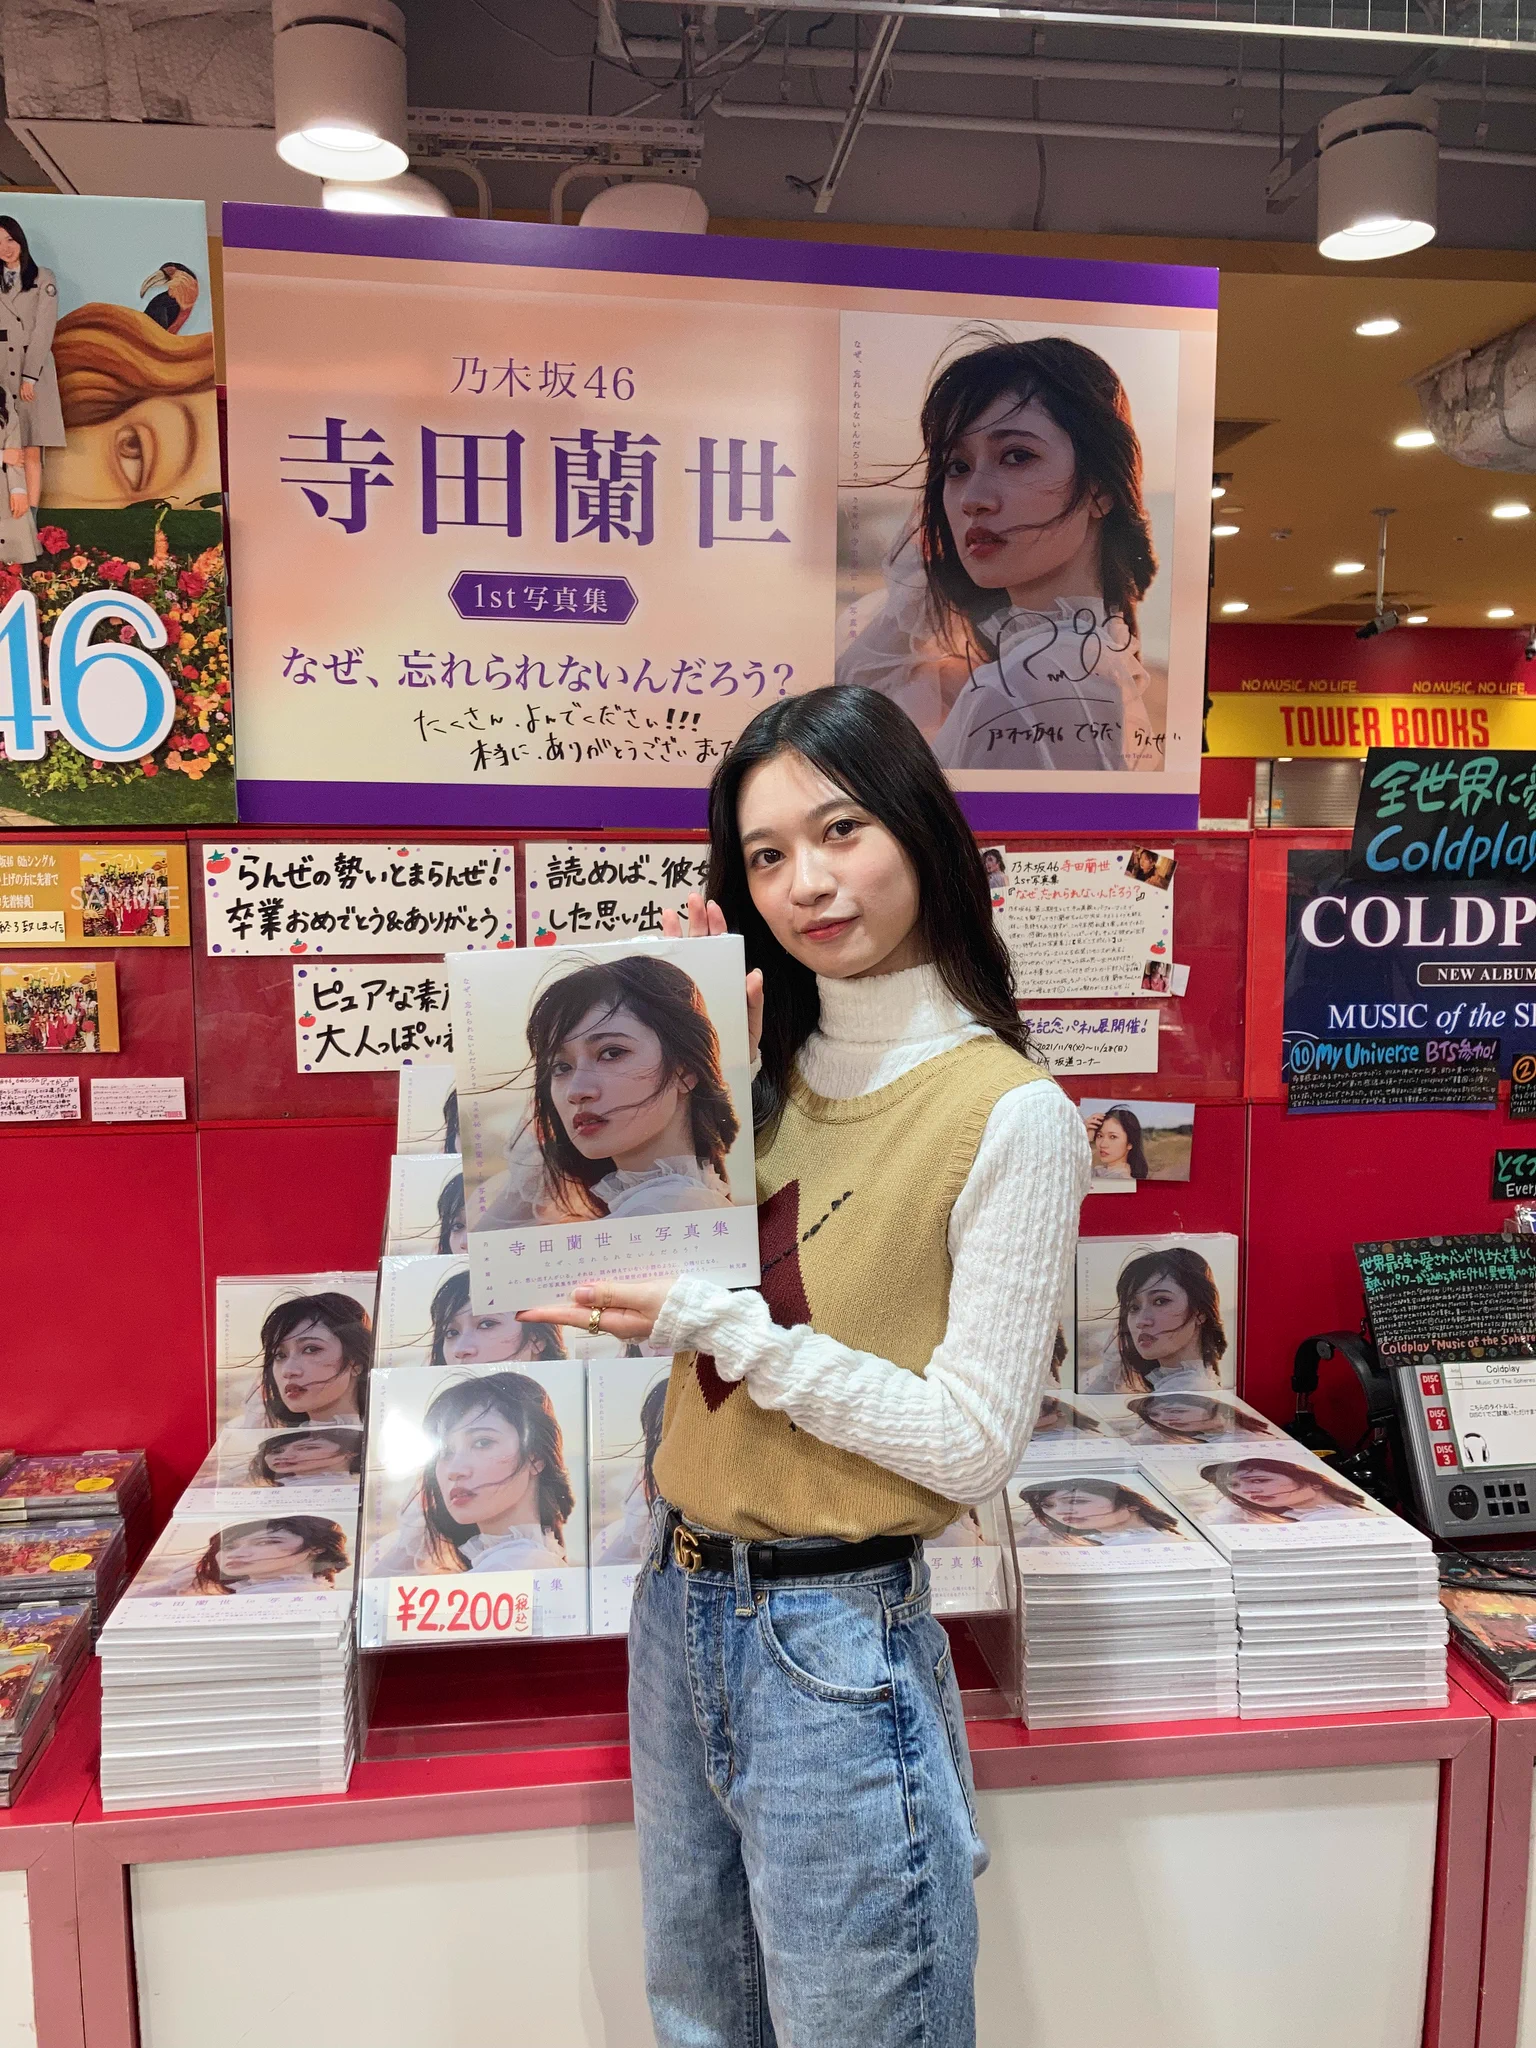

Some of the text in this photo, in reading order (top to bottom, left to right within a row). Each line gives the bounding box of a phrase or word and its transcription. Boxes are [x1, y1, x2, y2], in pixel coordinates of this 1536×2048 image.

[450, 356, 636, 401] 乃木坂46
[279, 416, 797, 549] 寺田蘭世
[1241, 679, 1262, 692] NO
[1308, 680, 1328, 692] NO
[1412, 680, 1432, 693] NO
[1478, 681, 1497, 694] NO
[1280, 706, 1490, 748] TOWER BOOKS
[236, 852, 501, 890] らんぜの勢いとまらんぜ!
[0, 873, 59, 886] 上げの方に先着で
[226, 898, 499, 940] 卒業おめでとう&ありがとう
[1301, 896, 1536, 948] COLDP
[1437, 967, 1536, 981] NEW ALBUM
[1327, 1003, 1429, 1029] MUSIC
[1436, 1003, 1467, 1035] of
[1468, 1003, 1506, 1029] the
[1345, 1043, 1420, 1070] Universe
[1467, 1336, 1480, 1349] of
[1481, 1335, 1499, 1347] the
[1486, 1364, 1520, 1374] Coldplay
[1422, 1374, 1440, 1384] DISC
[1429, 1384, 1437, 1395] 1
[1429, 1409, 1446, 1419] DISC
[1436, 1420, 1444, 1430] 2
[1436, 1445, 1454, 1454] DISC
[1443, 1454, 1451, 1465] 3
[396, 1586, 514, 1632] ¥2,200
